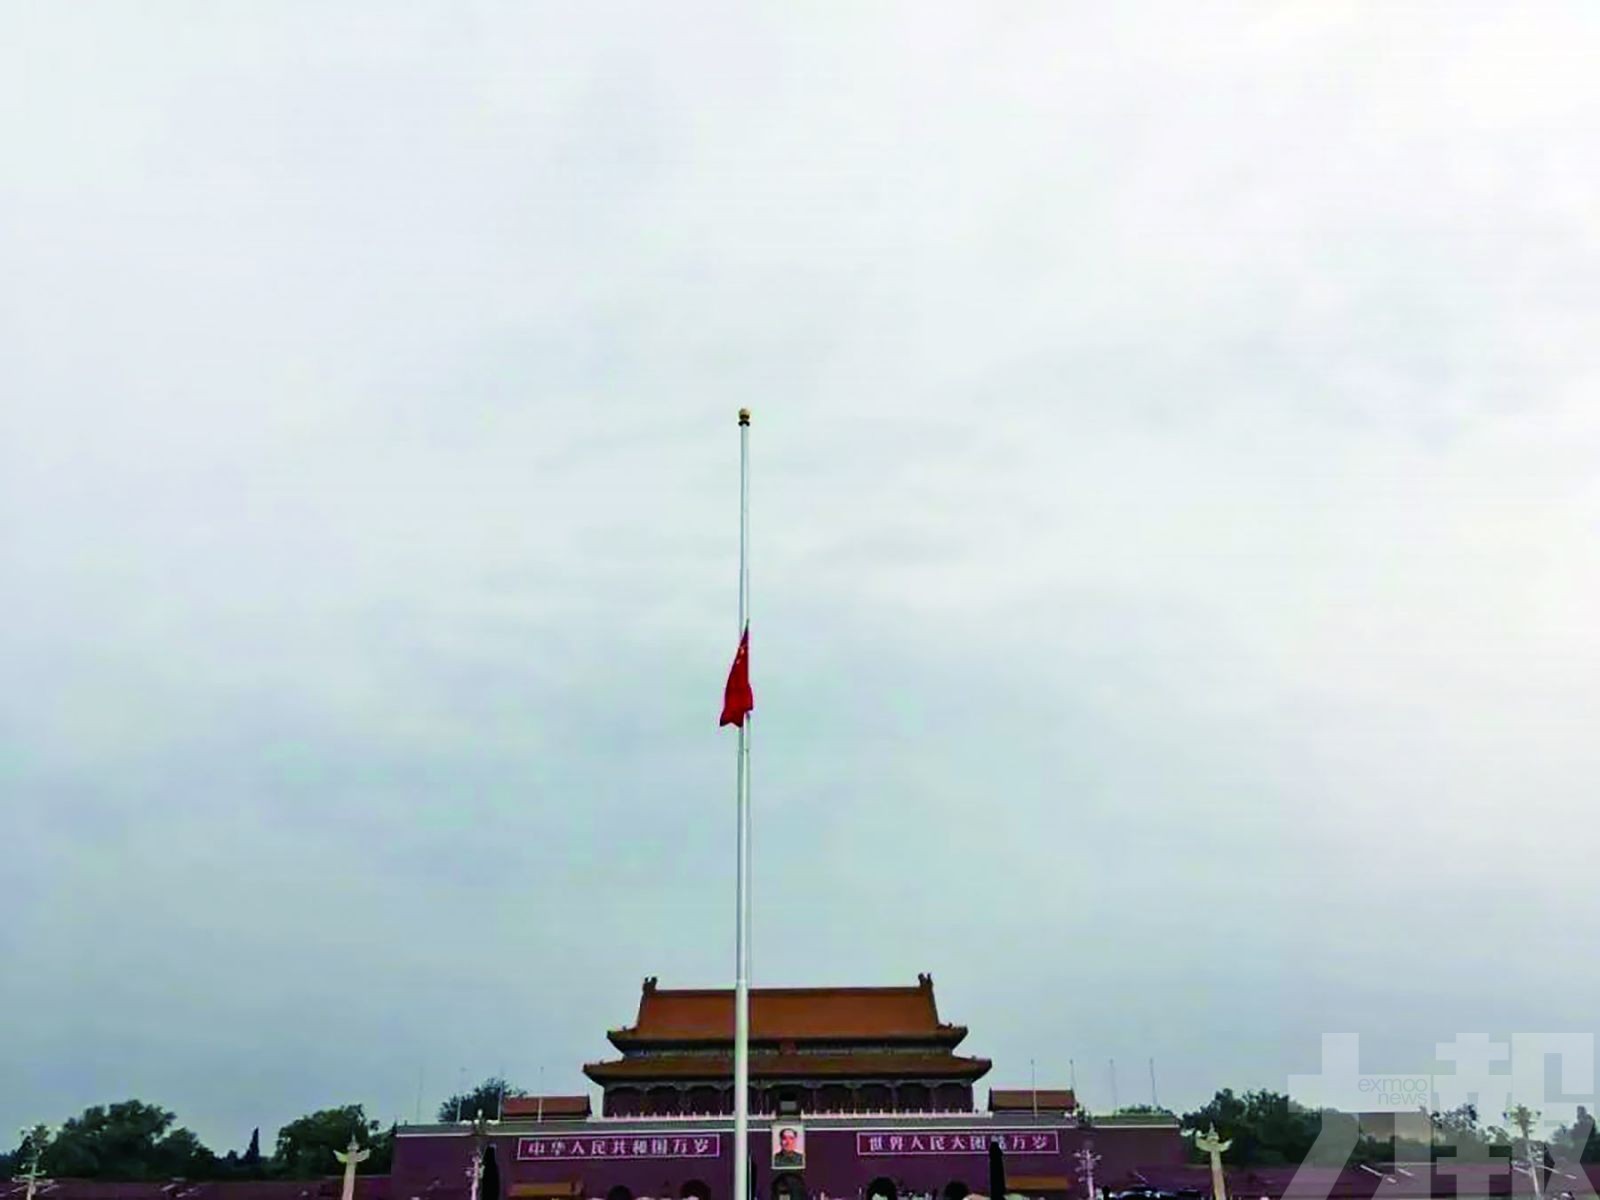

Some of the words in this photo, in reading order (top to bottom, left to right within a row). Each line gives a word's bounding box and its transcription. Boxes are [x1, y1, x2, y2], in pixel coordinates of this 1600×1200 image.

[528, 1137, 709, 1156] 中华人民共和国万岁
